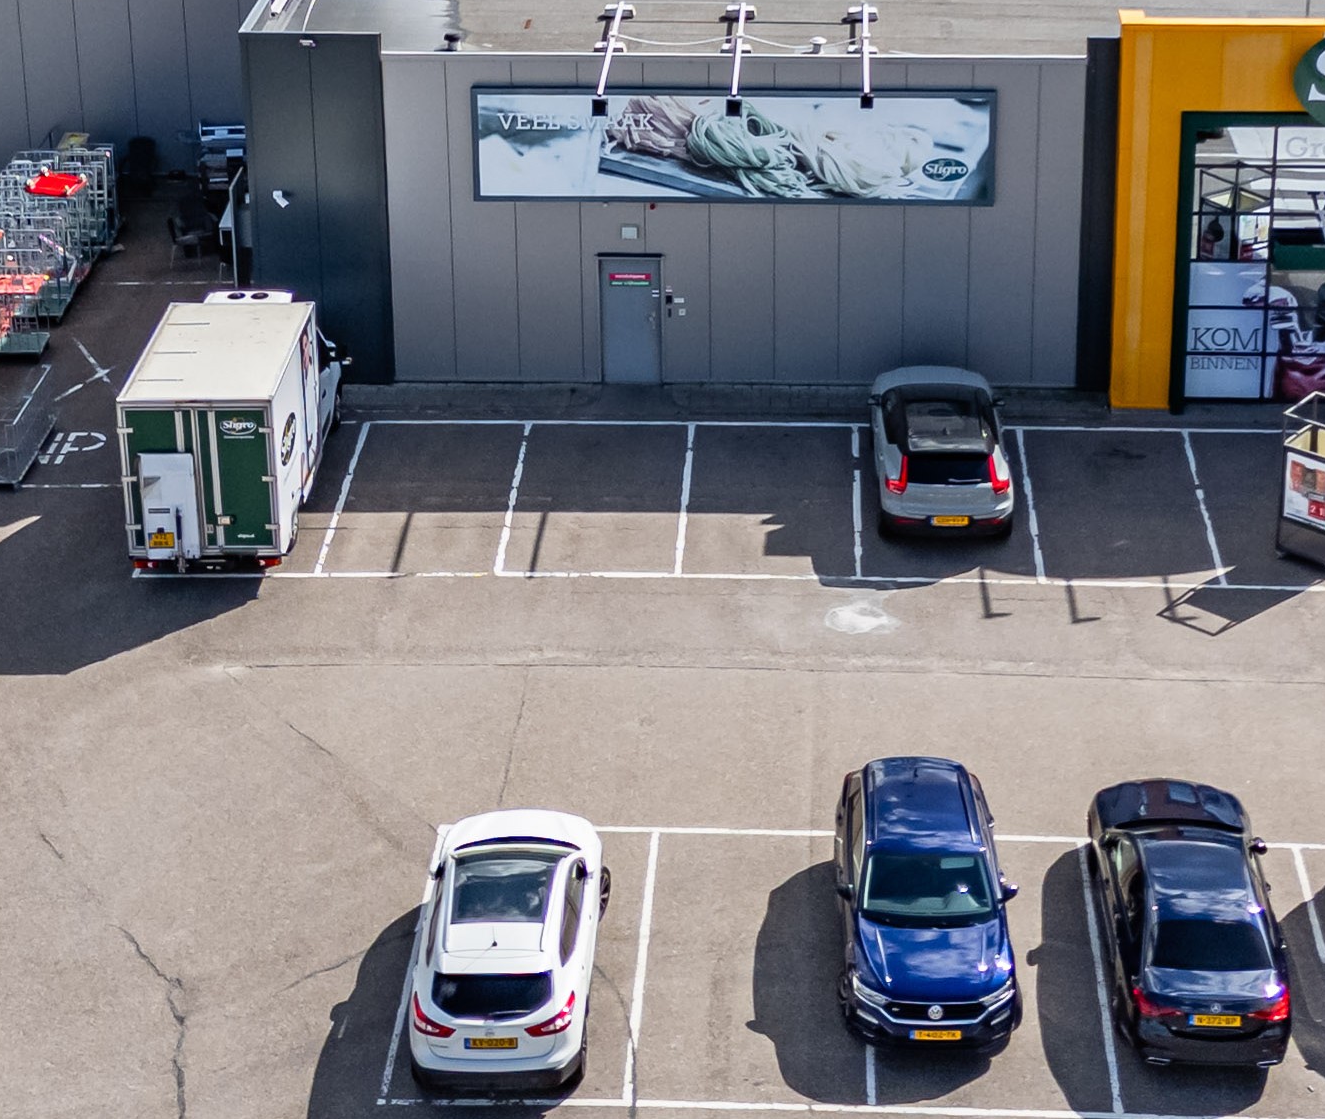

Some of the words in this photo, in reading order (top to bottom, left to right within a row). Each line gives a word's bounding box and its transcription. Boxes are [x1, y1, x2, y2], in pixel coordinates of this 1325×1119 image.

[496, 113, 561, 131] VEEL
[566, 113, 654, 131] SMAAK
[925, 163, 967, 177] Sligro
[1190, 327, 1262, 351] KOM
[1190, 357, 1260, 370] BINNEN
[222, 421, 254, 431] Sligro
